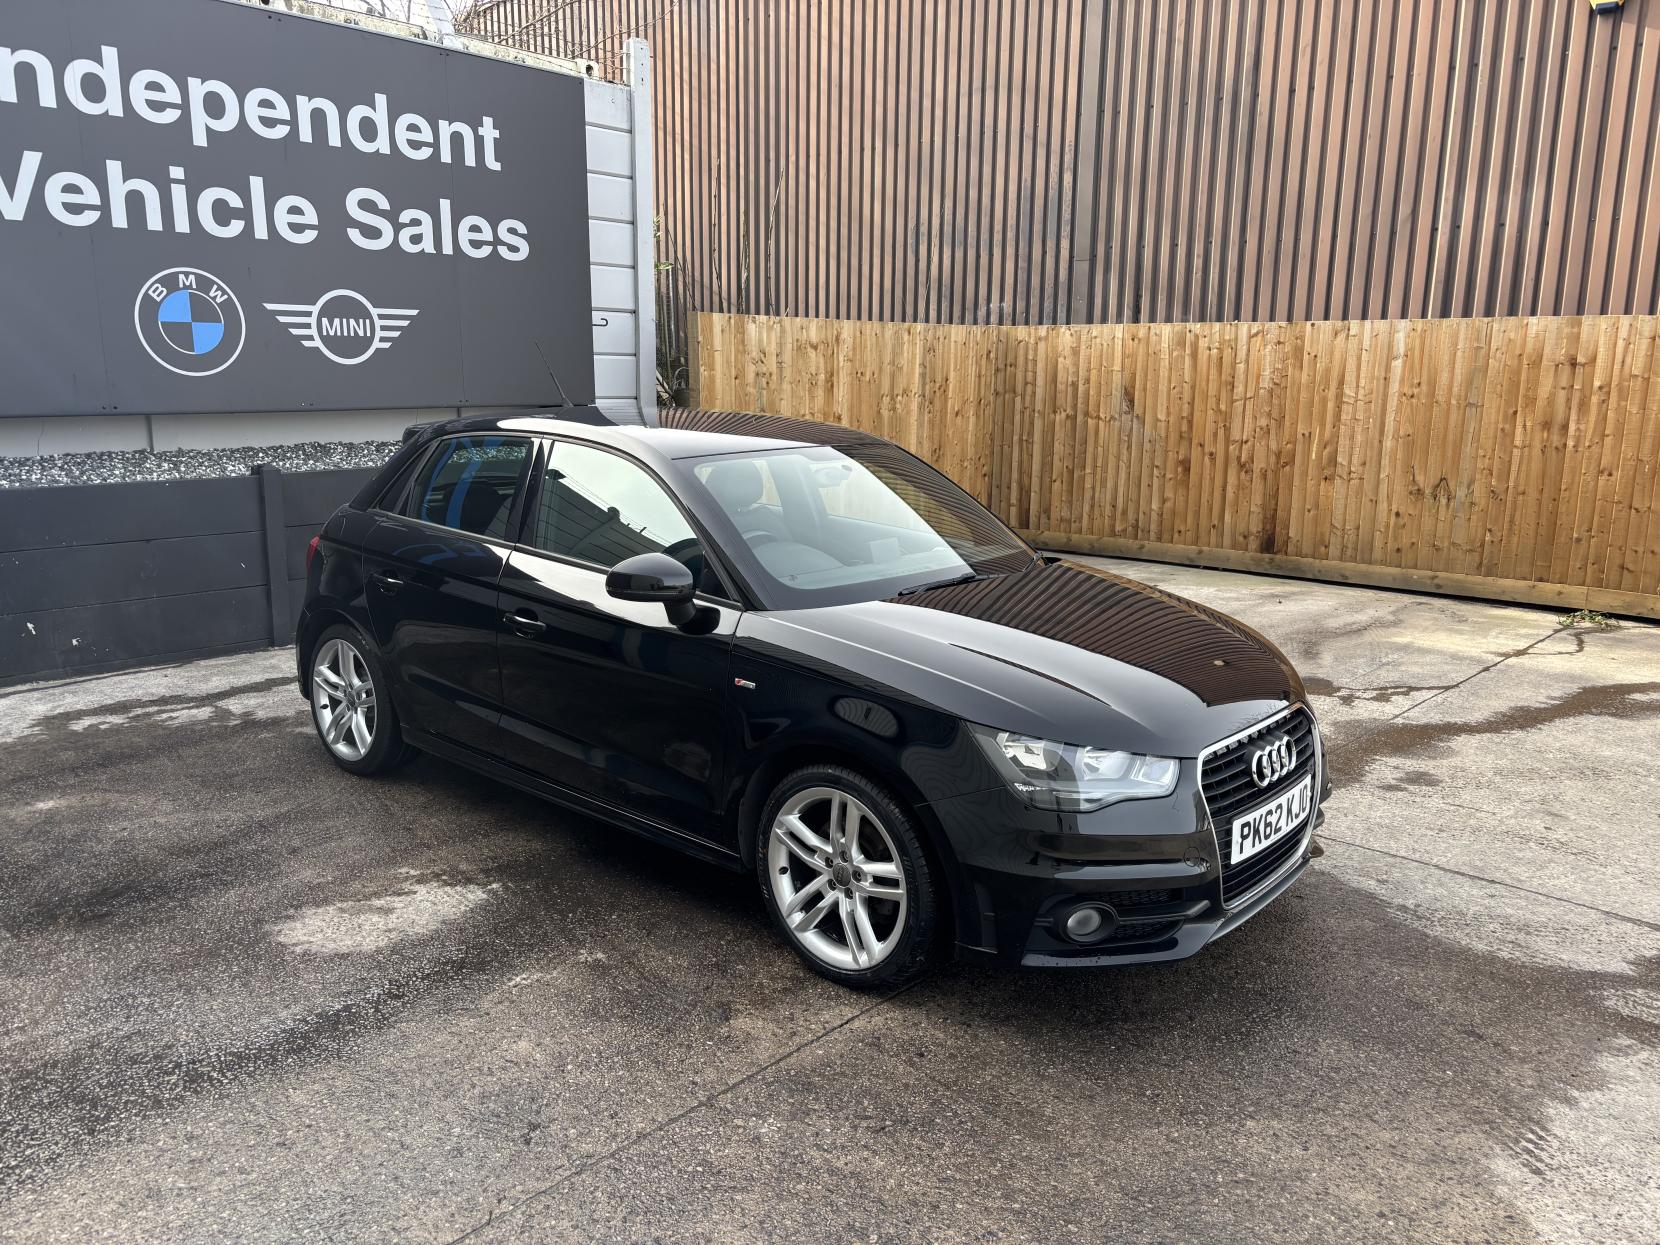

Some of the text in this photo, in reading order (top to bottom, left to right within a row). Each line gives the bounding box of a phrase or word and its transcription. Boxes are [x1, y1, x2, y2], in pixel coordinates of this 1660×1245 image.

[0, 150, 530, 262] Vehicle Sales
[147, 273, 229, 304] BMW
[321, 317, 372, 338] MINI
[1239, 803, 1283, 855] PK62
